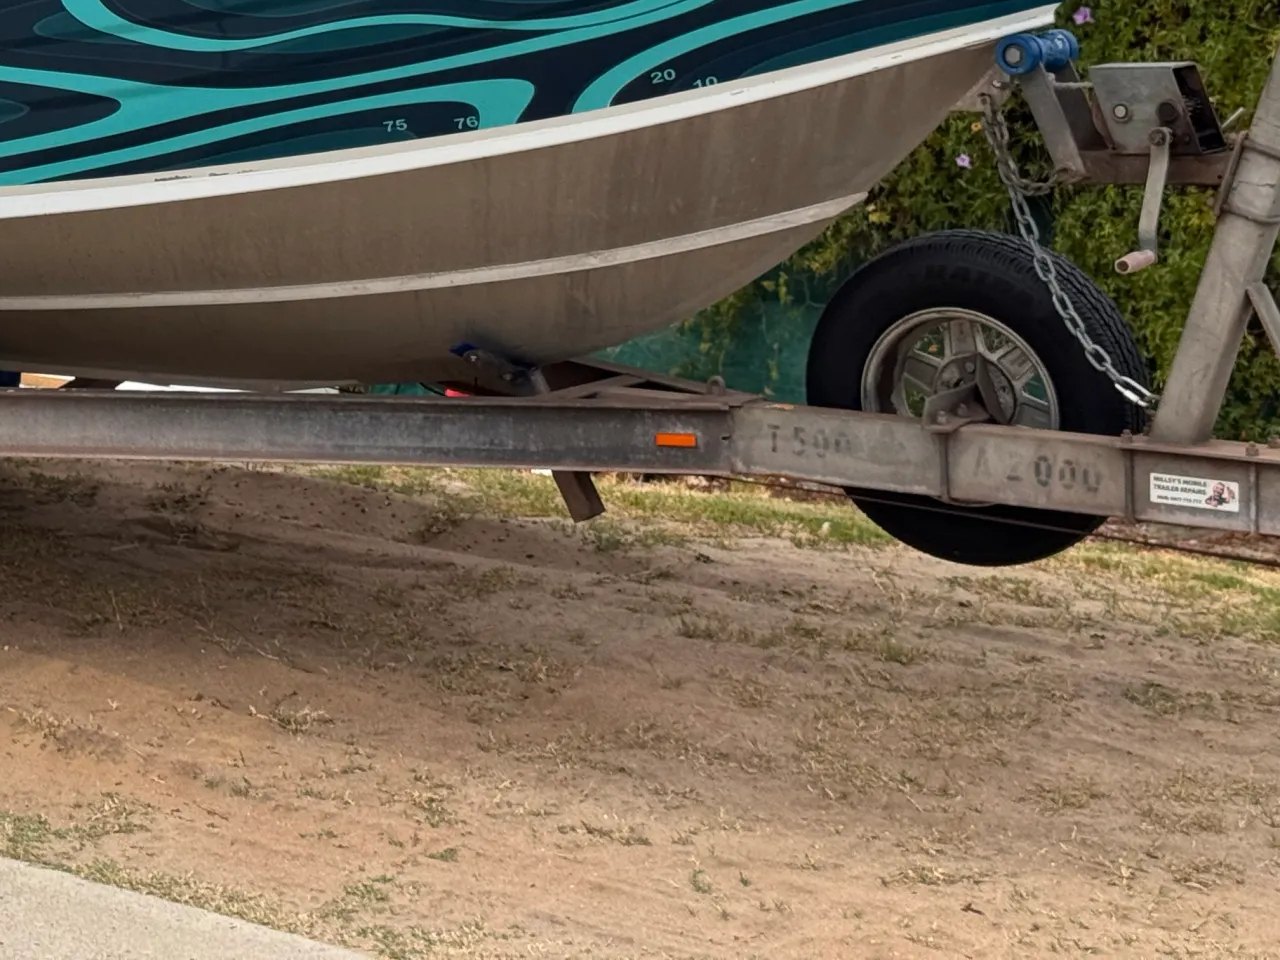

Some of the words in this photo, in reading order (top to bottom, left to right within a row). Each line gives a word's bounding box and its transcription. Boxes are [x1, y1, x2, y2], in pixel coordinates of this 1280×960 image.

[651, 68, 676, 84] 20
[382, 118, 408, 133] 75
[453, 115, 478, 130] 76
